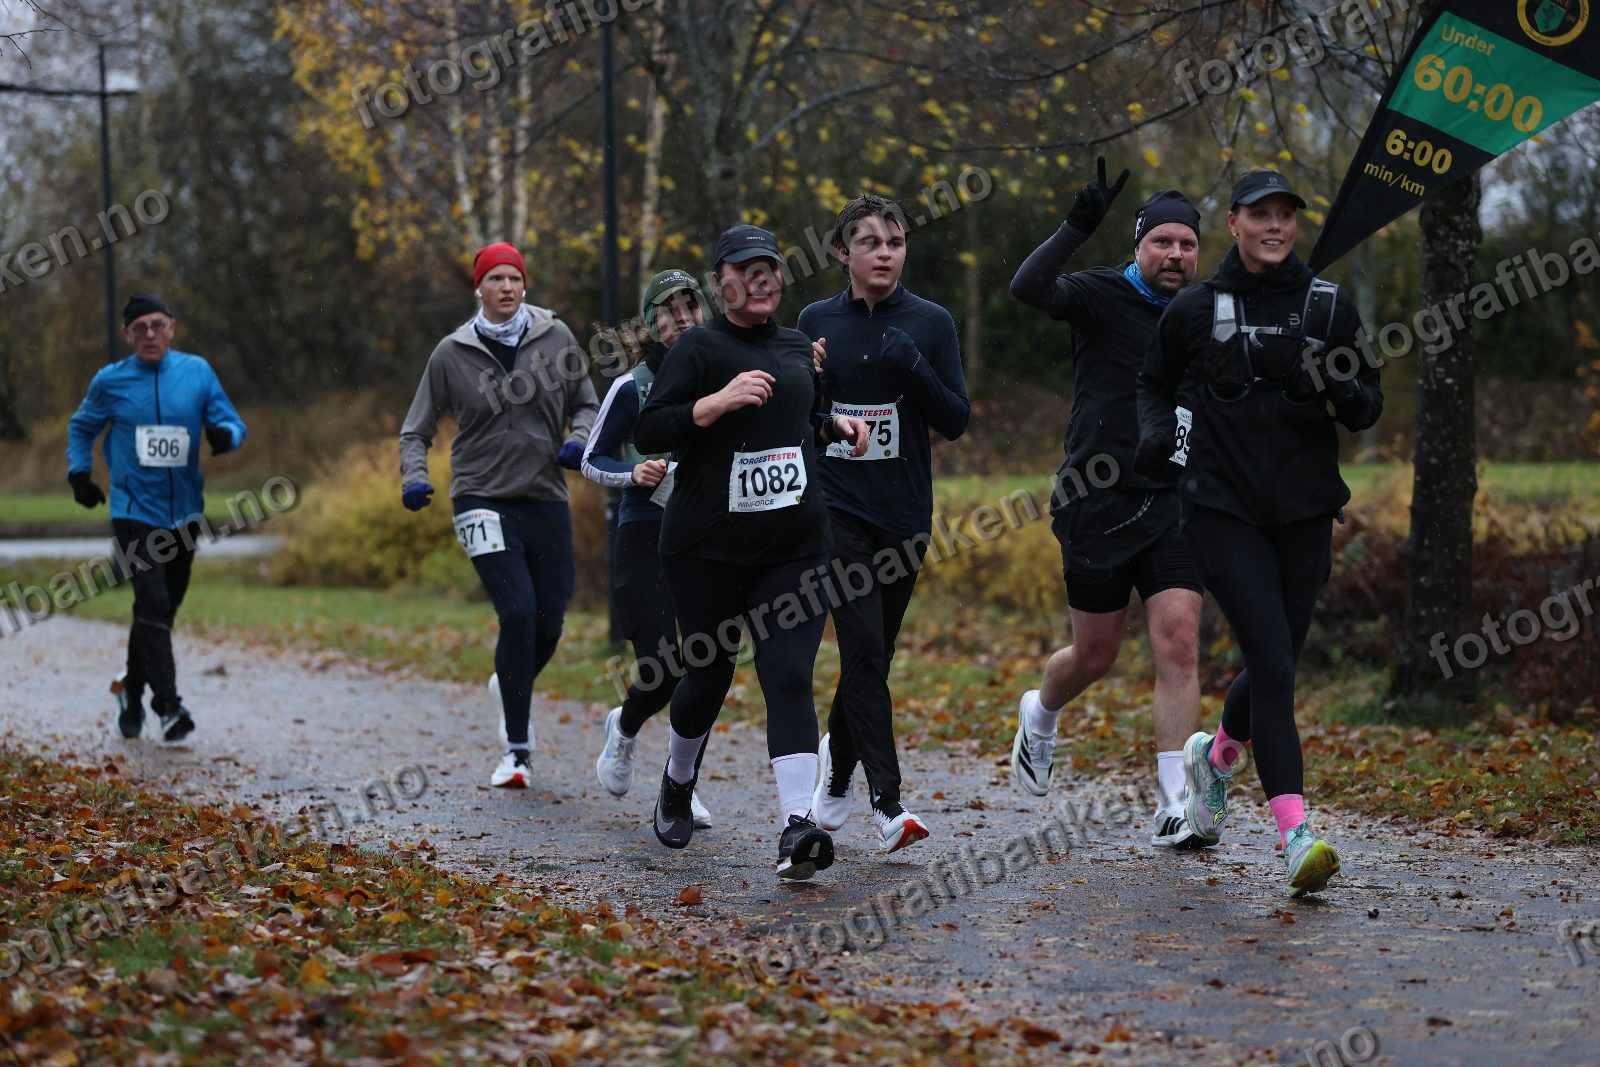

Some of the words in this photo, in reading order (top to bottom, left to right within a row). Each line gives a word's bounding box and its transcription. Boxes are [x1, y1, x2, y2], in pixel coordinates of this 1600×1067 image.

[1440, 23, 1496, 56] Under
[1413, 53, 1543, 133] 60:00
[1385, 129, 1453, 175] 6:00
[1363, 161, 1426, 197] min/km
[147, 438, 180, 458] 506
[738, 463, 802, 497] 1082
[460, 520, 487, 548] 371
